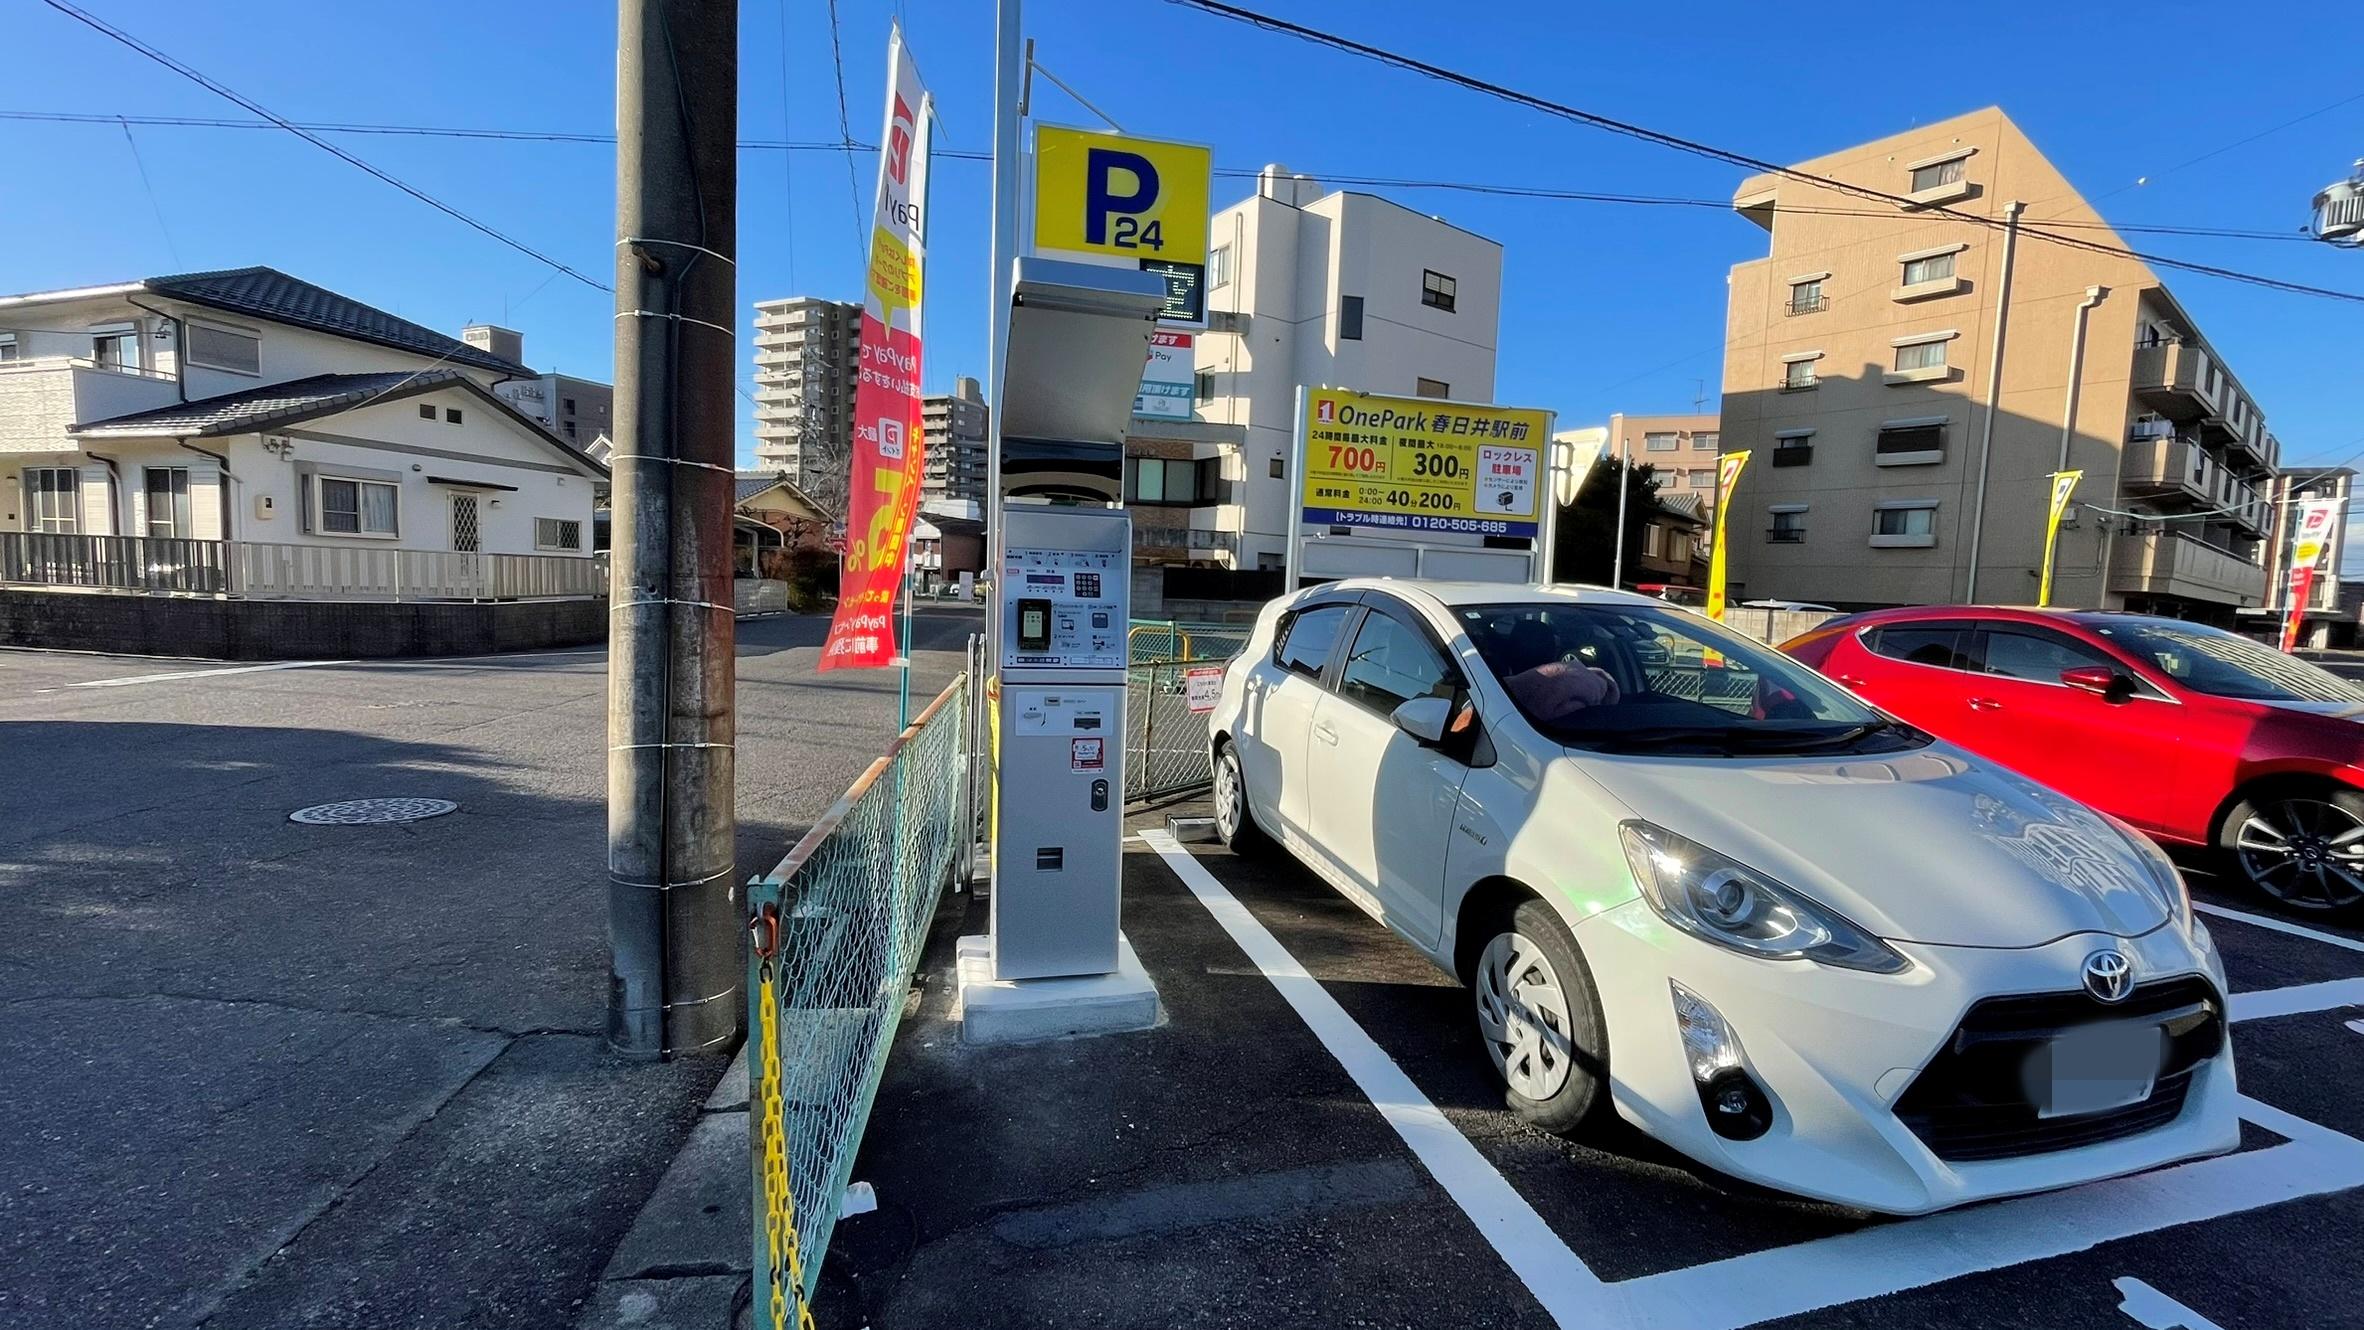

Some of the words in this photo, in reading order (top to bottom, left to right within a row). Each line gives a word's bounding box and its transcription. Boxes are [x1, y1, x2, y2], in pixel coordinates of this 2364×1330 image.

[1086, 147, 1160, 246] P
[1114, 217, 1164, 252] 24
[1155, 351, 1172, 362] Pay
[1339, 405, 1427, 432] OnePark
[1431, 414, 1530, 441] 春日井駅前
[1399, 438, 1435, 450] 夜間最大
[1483, 449, 1533, 463] ロックレス
[1316, 487, 1350, 500] 通常料金
[1358, 496, 1382, 506] 24:00
[1412, 516, 1507, 534] 0120-505-685
